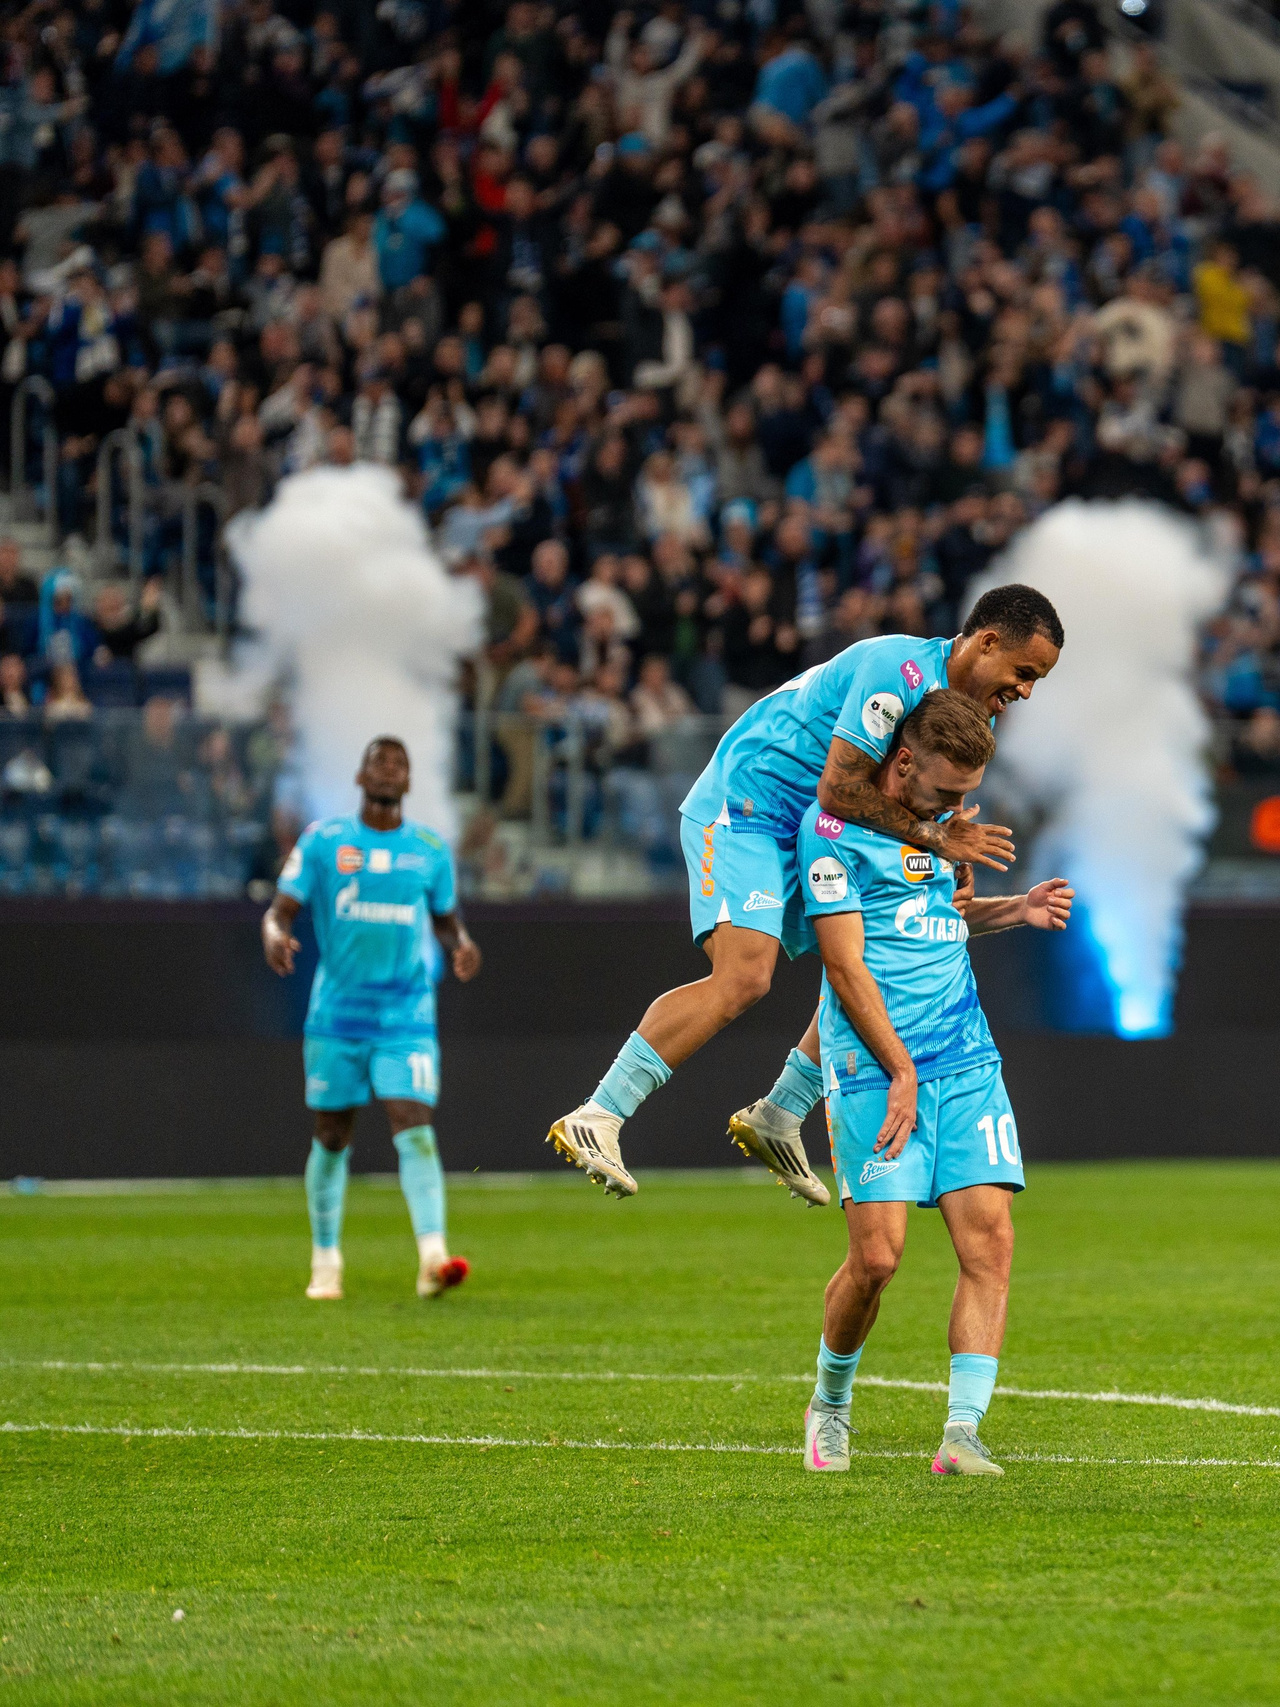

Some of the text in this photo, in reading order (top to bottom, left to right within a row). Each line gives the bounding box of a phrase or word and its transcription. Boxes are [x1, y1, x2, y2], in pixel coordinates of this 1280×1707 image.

[905, 662, 920, 687] wb
[818, 816, 842, 833] wb
[977, 1113, 1019, 1166] 10
